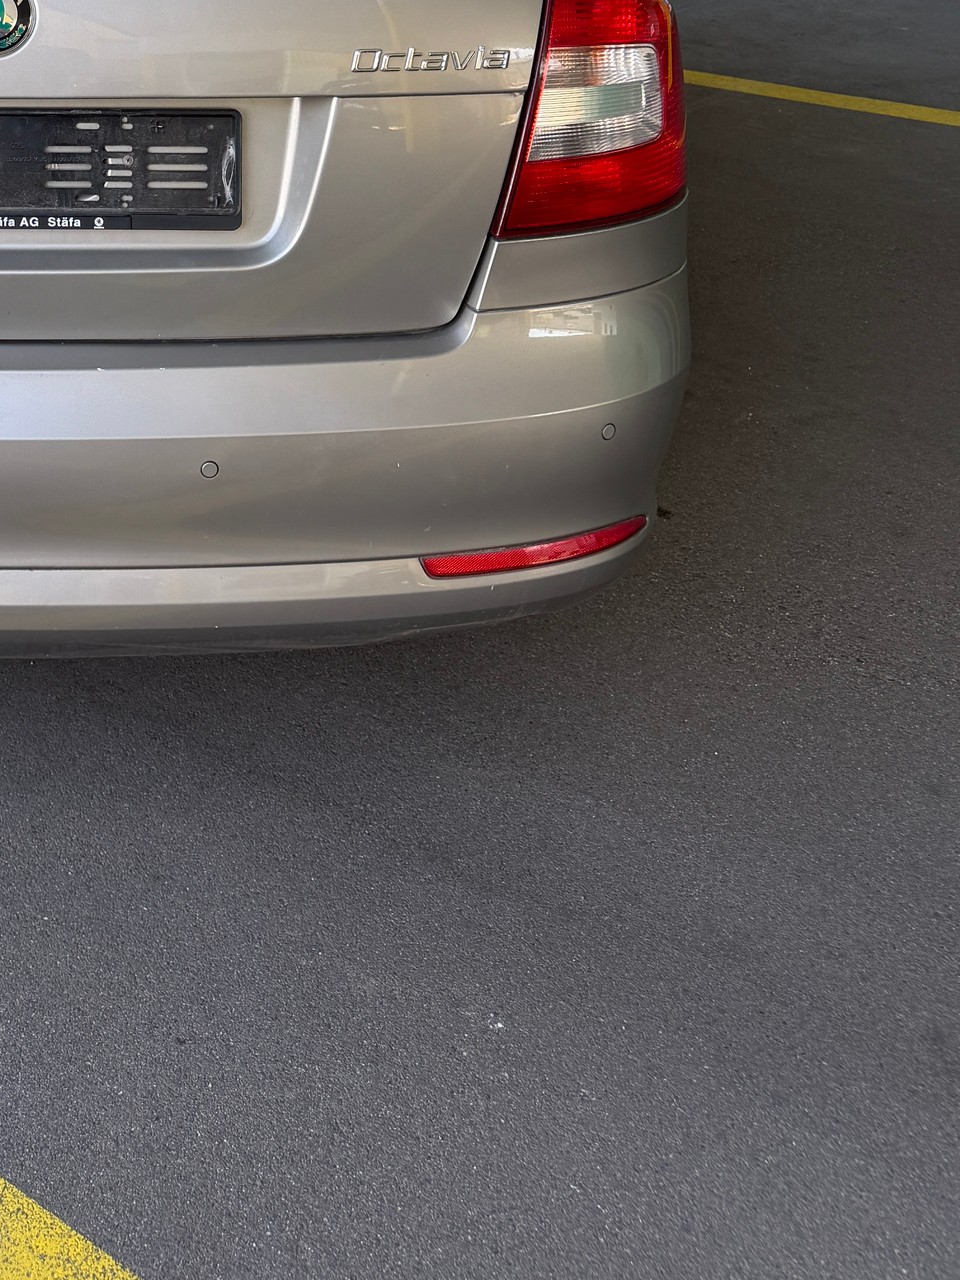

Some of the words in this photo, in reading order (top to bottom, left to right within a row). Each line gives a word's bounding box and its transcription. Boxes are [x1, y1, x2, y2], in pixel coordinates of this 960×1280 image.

[350, 45, 511, 73] Octavia
[19, 217, 39, 227] AG
[47, 216, 81, 228] Stäfa
